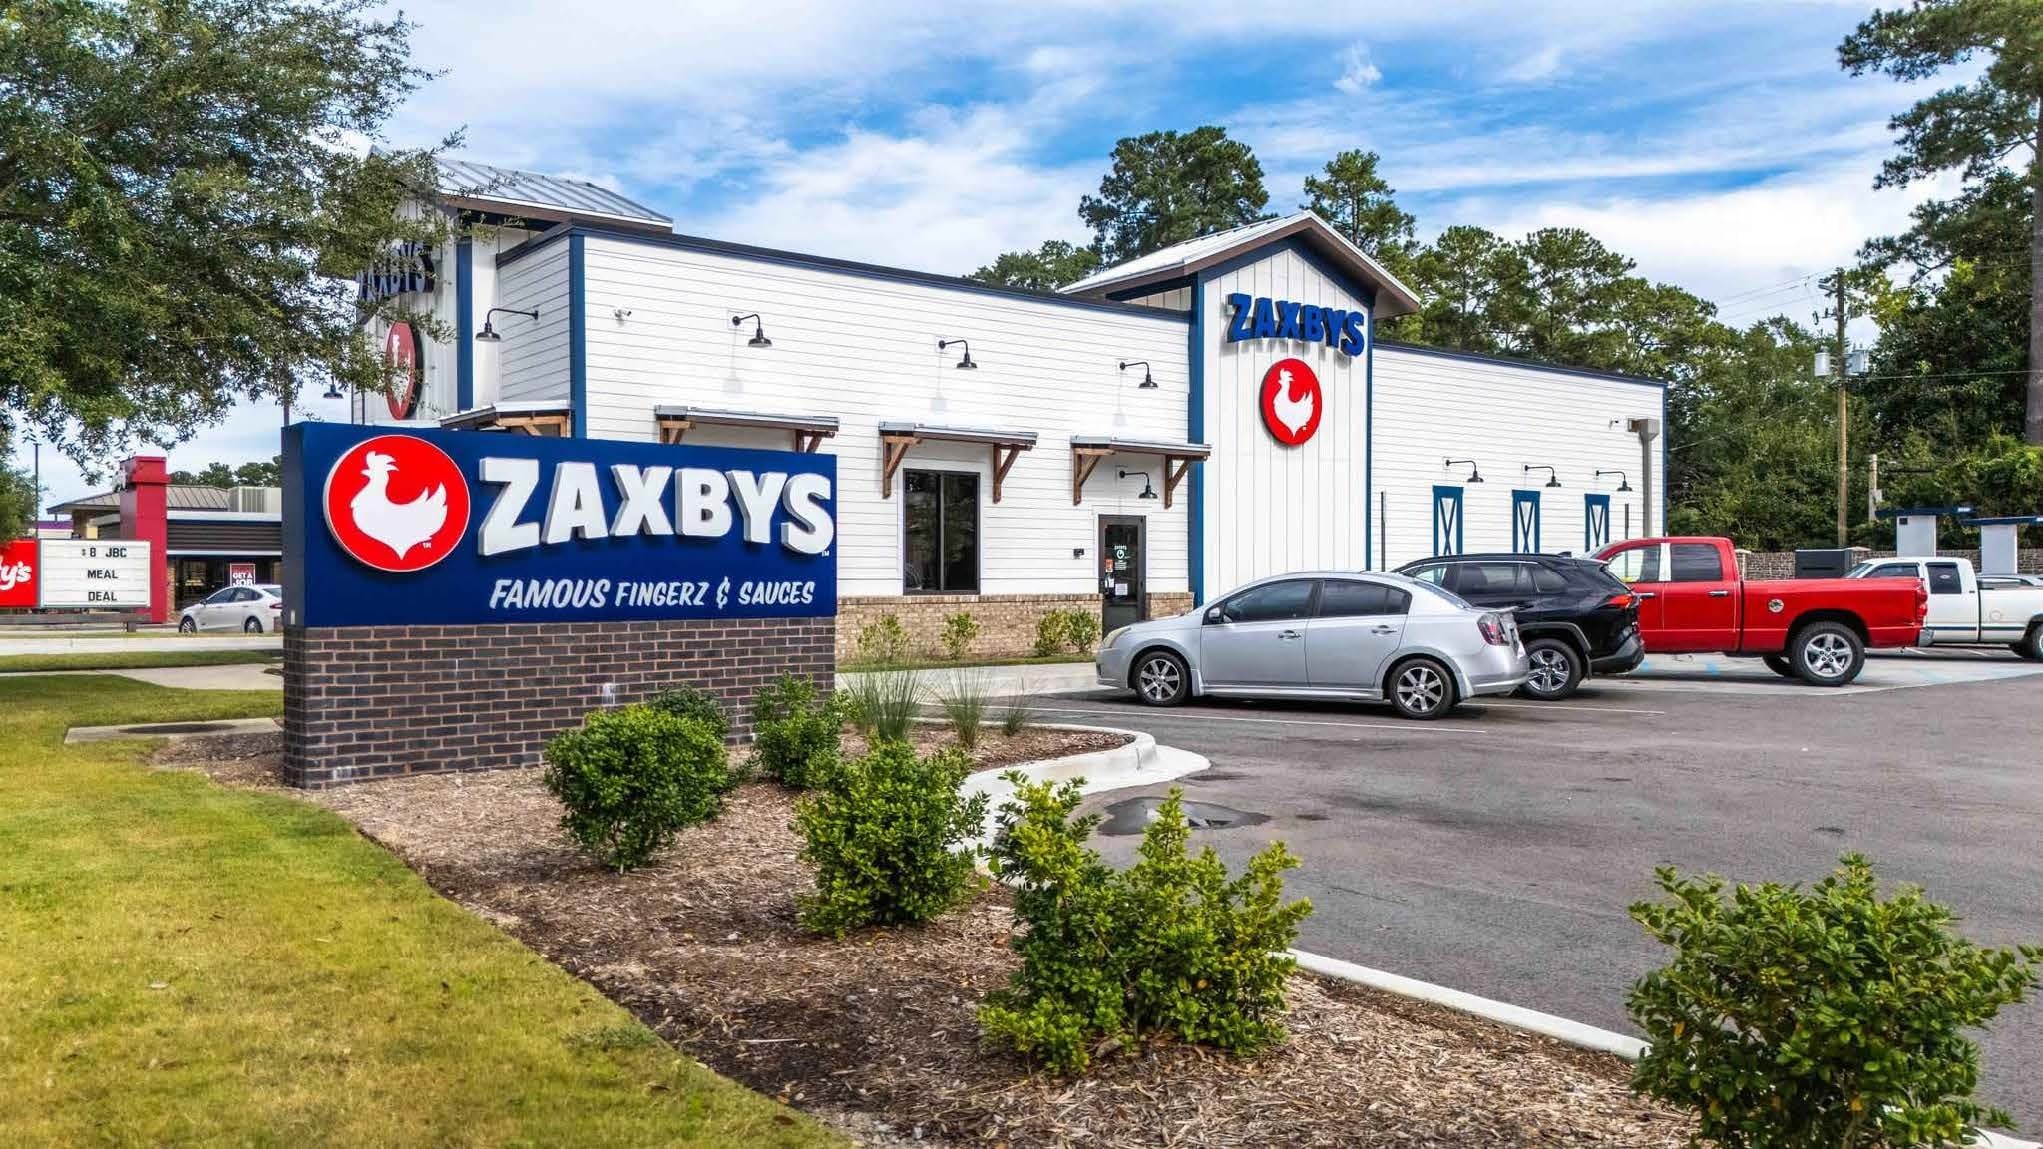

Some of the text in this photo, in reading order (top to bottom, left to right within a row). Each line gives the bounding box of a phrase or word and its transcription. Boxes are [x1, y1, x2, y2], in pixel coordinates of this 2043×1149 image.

[1226, 293, 1365, 357] ZAXBYS
[478, 457, 835, 556] ZAXBYS
[105, 547, 127, 558] JBC
[0, 555, 32, 591] y's
[87, 569, 118, 579] MEAL
[88, 591, 118, 602] DEAL
[489, 576, 815, 610] FAMOUS FINGERZ & SAUCES
